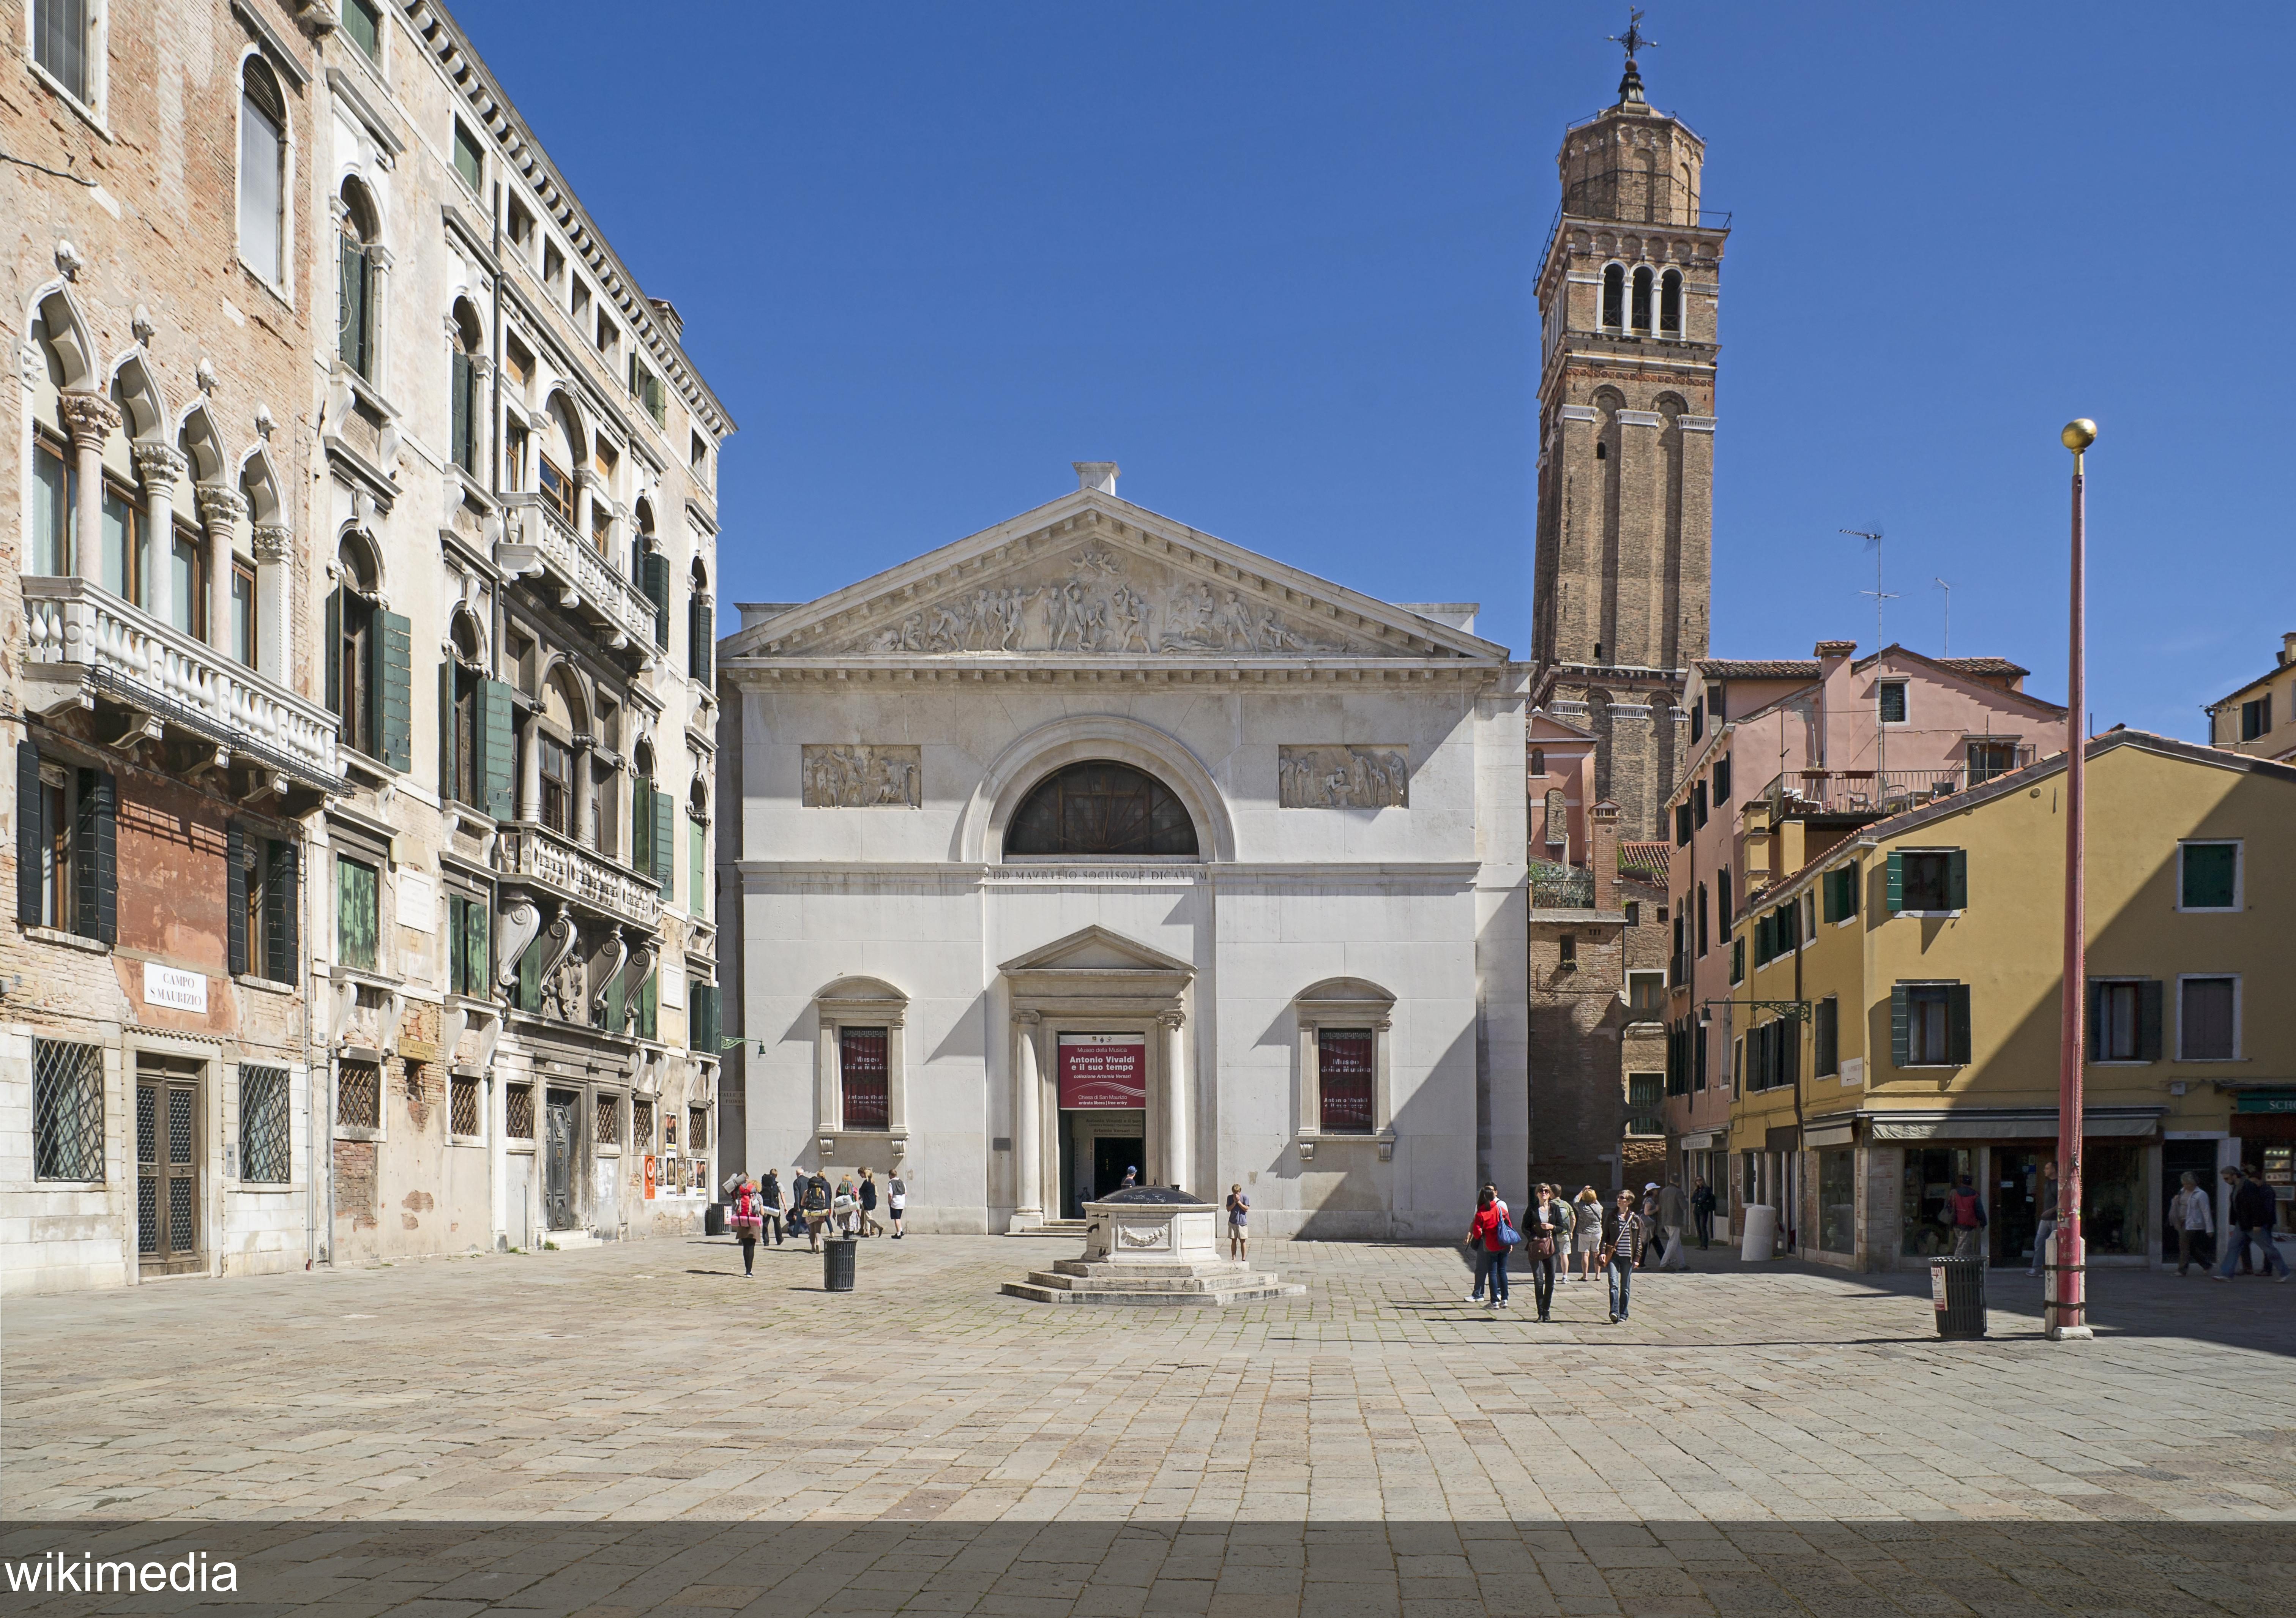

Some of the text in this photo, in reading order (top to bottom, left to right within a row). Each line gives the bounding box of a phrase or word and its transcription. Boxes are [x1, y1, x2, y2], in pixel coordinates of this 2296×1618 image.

[1016, 871, 1077, 880] MAVRITIO
[1151, 871, 1207, 880] DICATVM
[163, 973, 194, 988] CAMPO
[157, 988, 202, 1006] MAURIZIO
